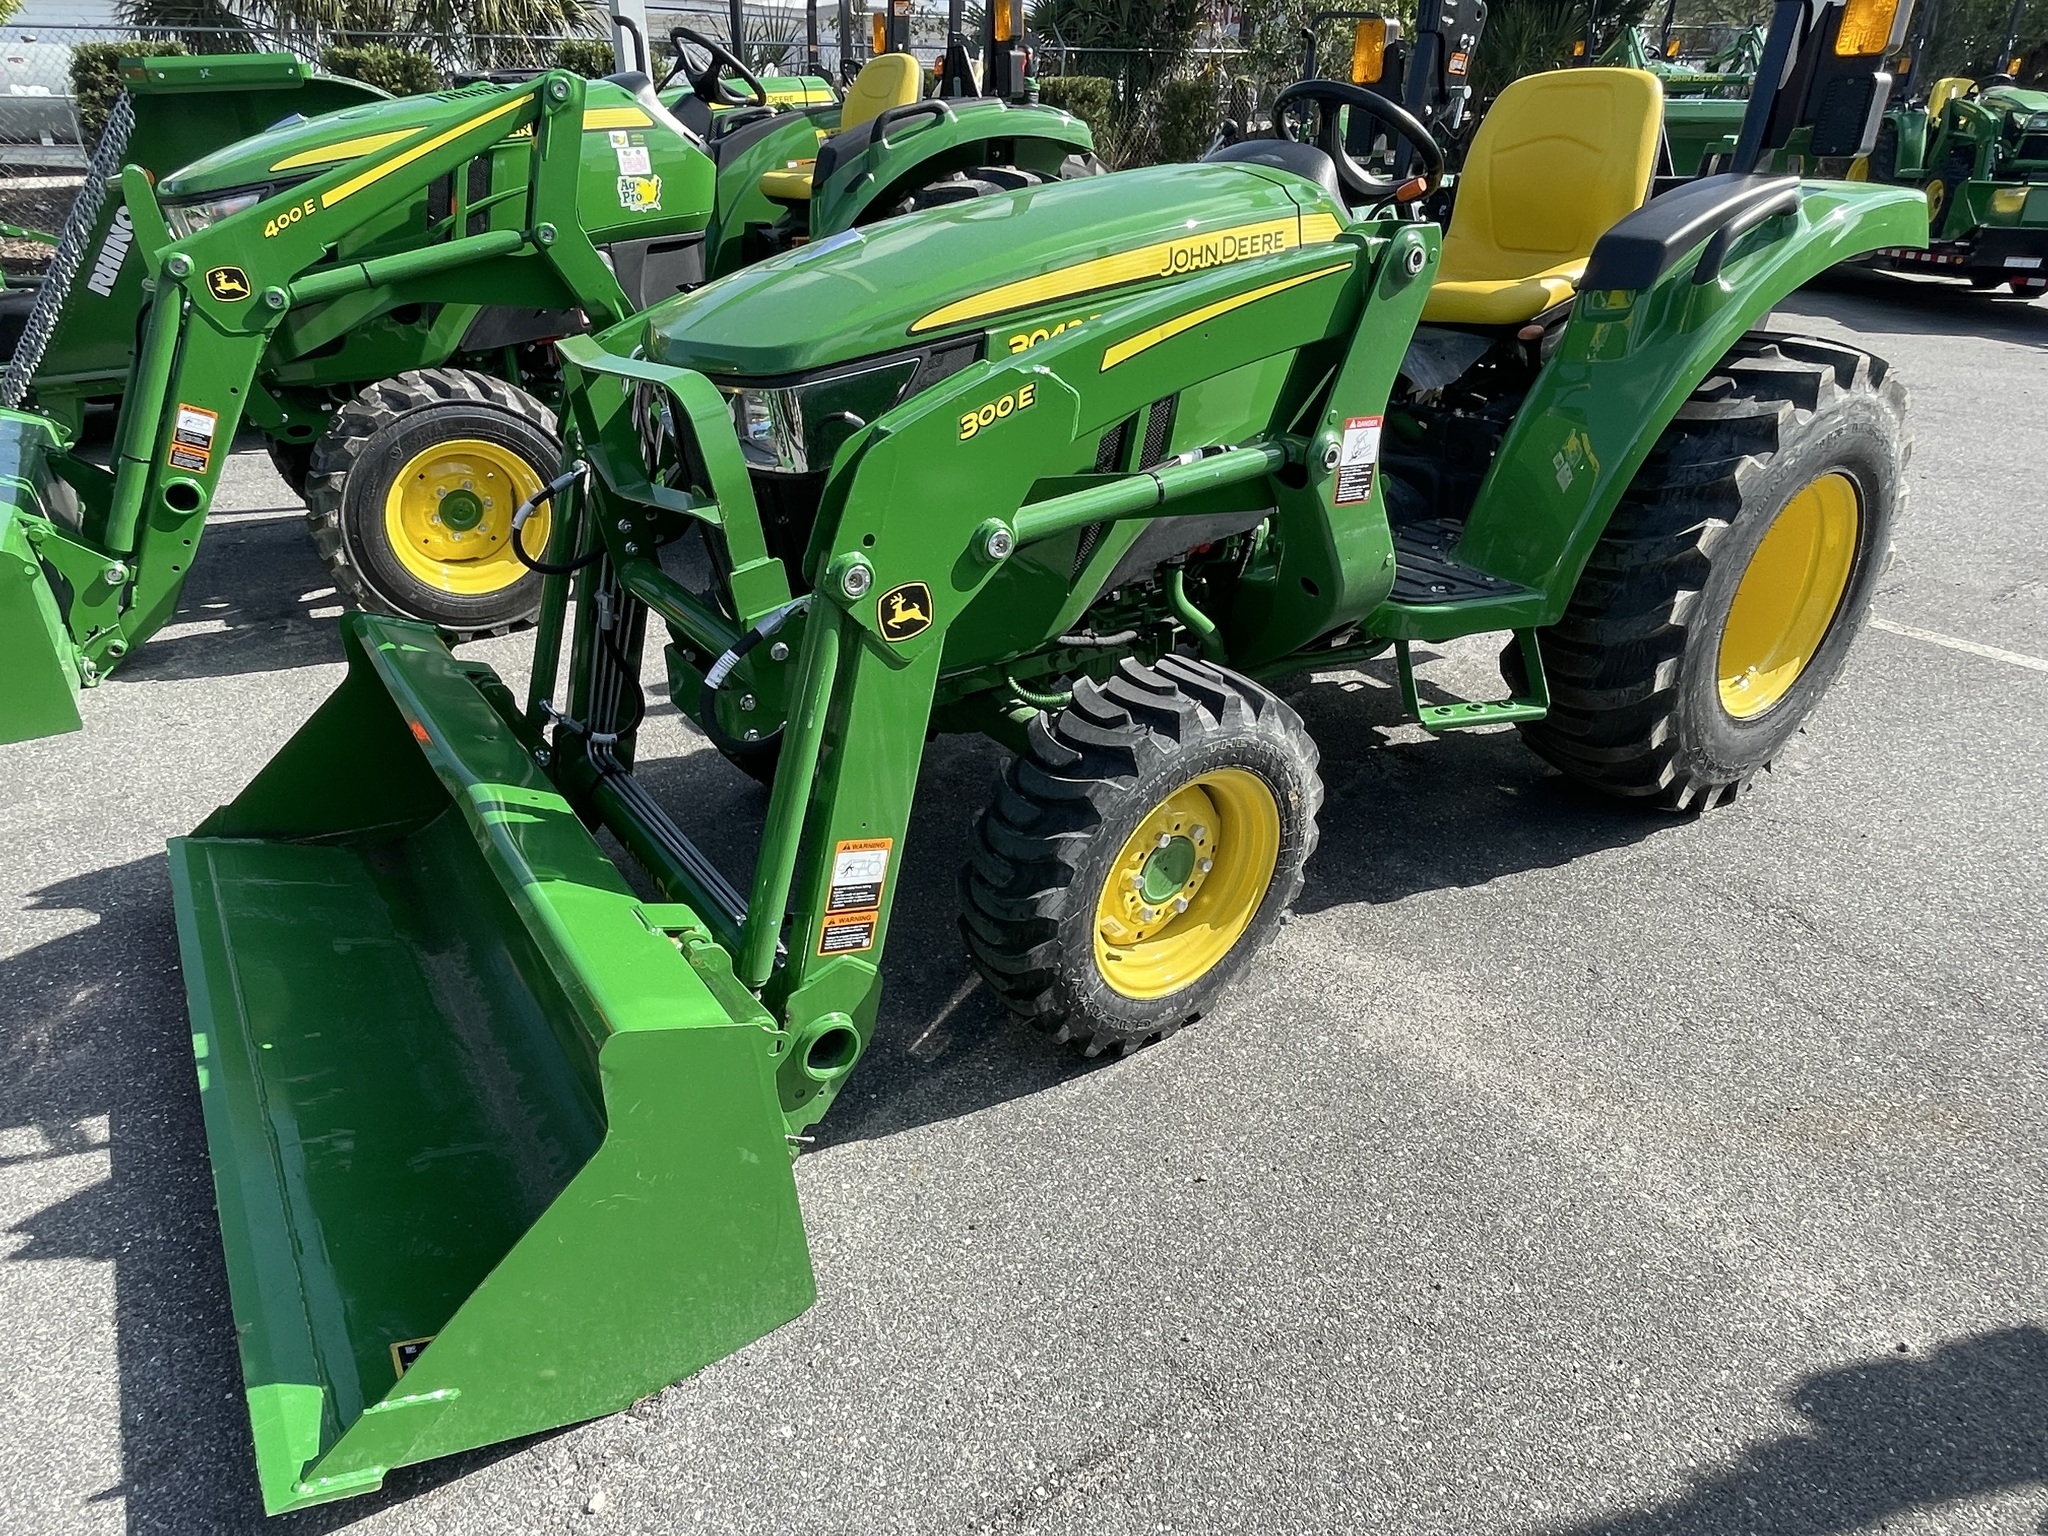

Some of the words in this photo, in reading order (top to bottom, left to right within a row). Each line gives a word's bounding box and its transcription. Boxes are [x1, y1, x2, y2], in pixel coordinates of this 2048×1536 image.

[1667, 74, 1692, 82] JOHN
[1693, 74, 1725, 82] DEERE
[767, 95, 794, 104] DEERE
[622, 191, 643, 204] Pro
[87, 205, 134, 297] RHINO
[1161, 242, 1218, 273] JOHN
[1222, 230, 1285, 260] DEERE
[851, 842, 886, 851] WARNING
[838, 914, 872, 924] WARNING
